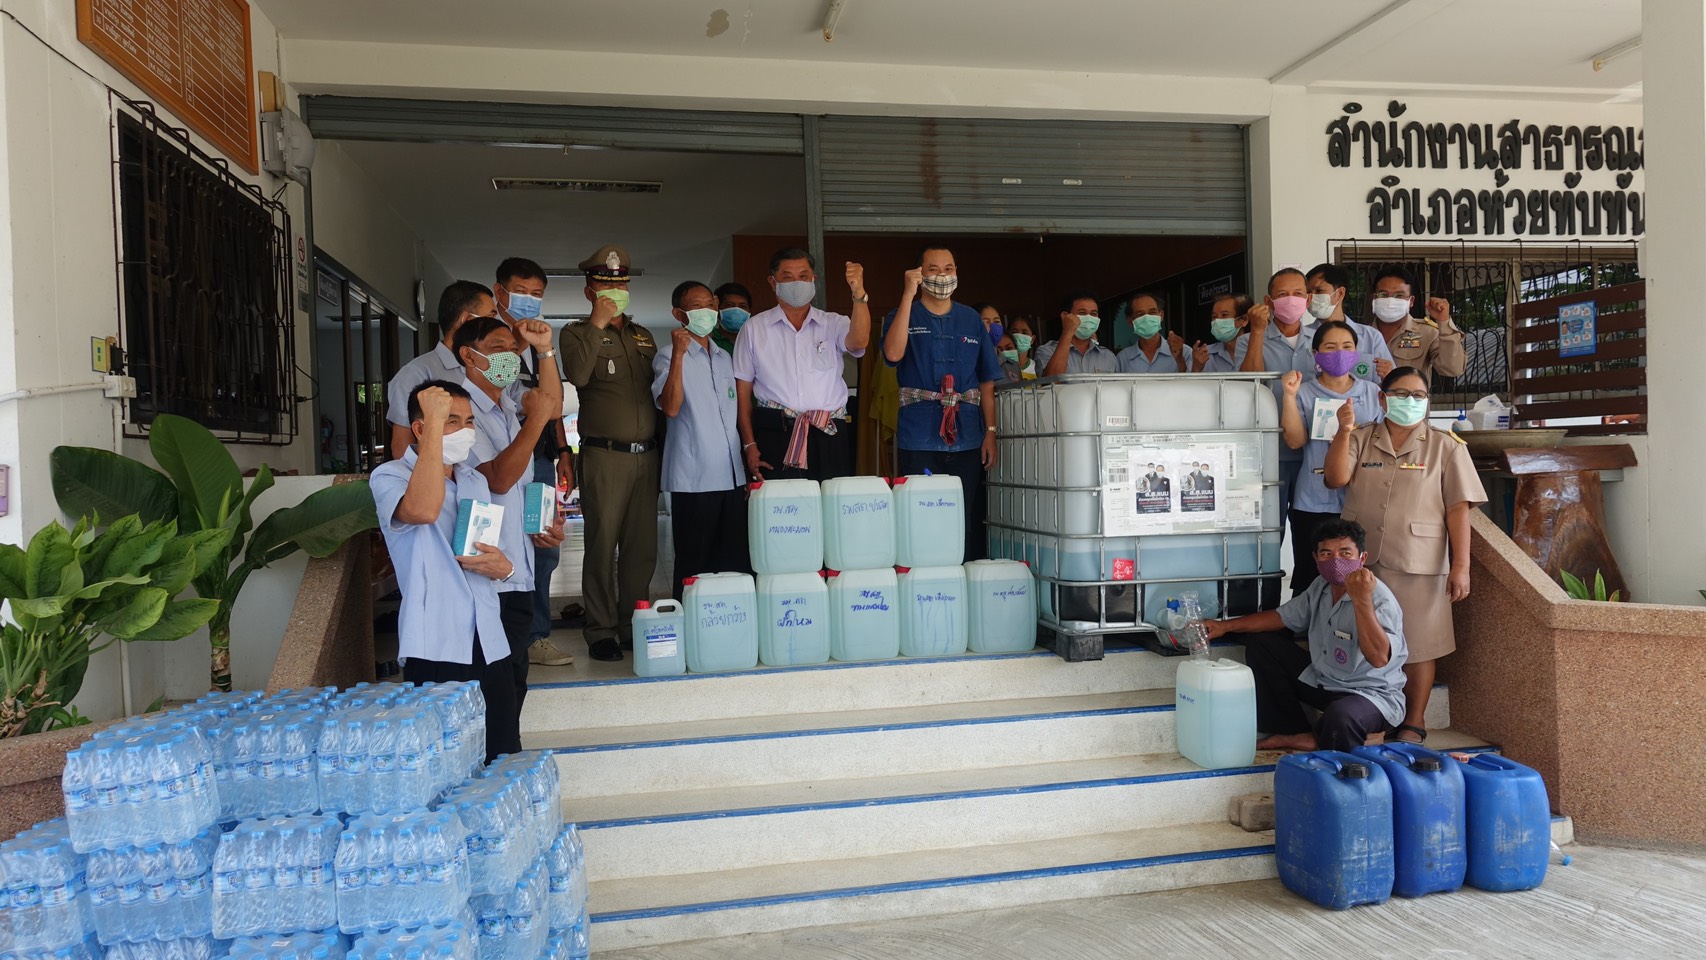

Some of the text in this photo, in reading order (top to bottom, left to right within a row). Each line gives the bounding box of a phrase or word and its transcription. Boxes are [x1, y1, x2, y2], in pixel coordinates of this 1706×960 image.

[1325, 100, 1645, 171] สำนักงานสาธารณ
